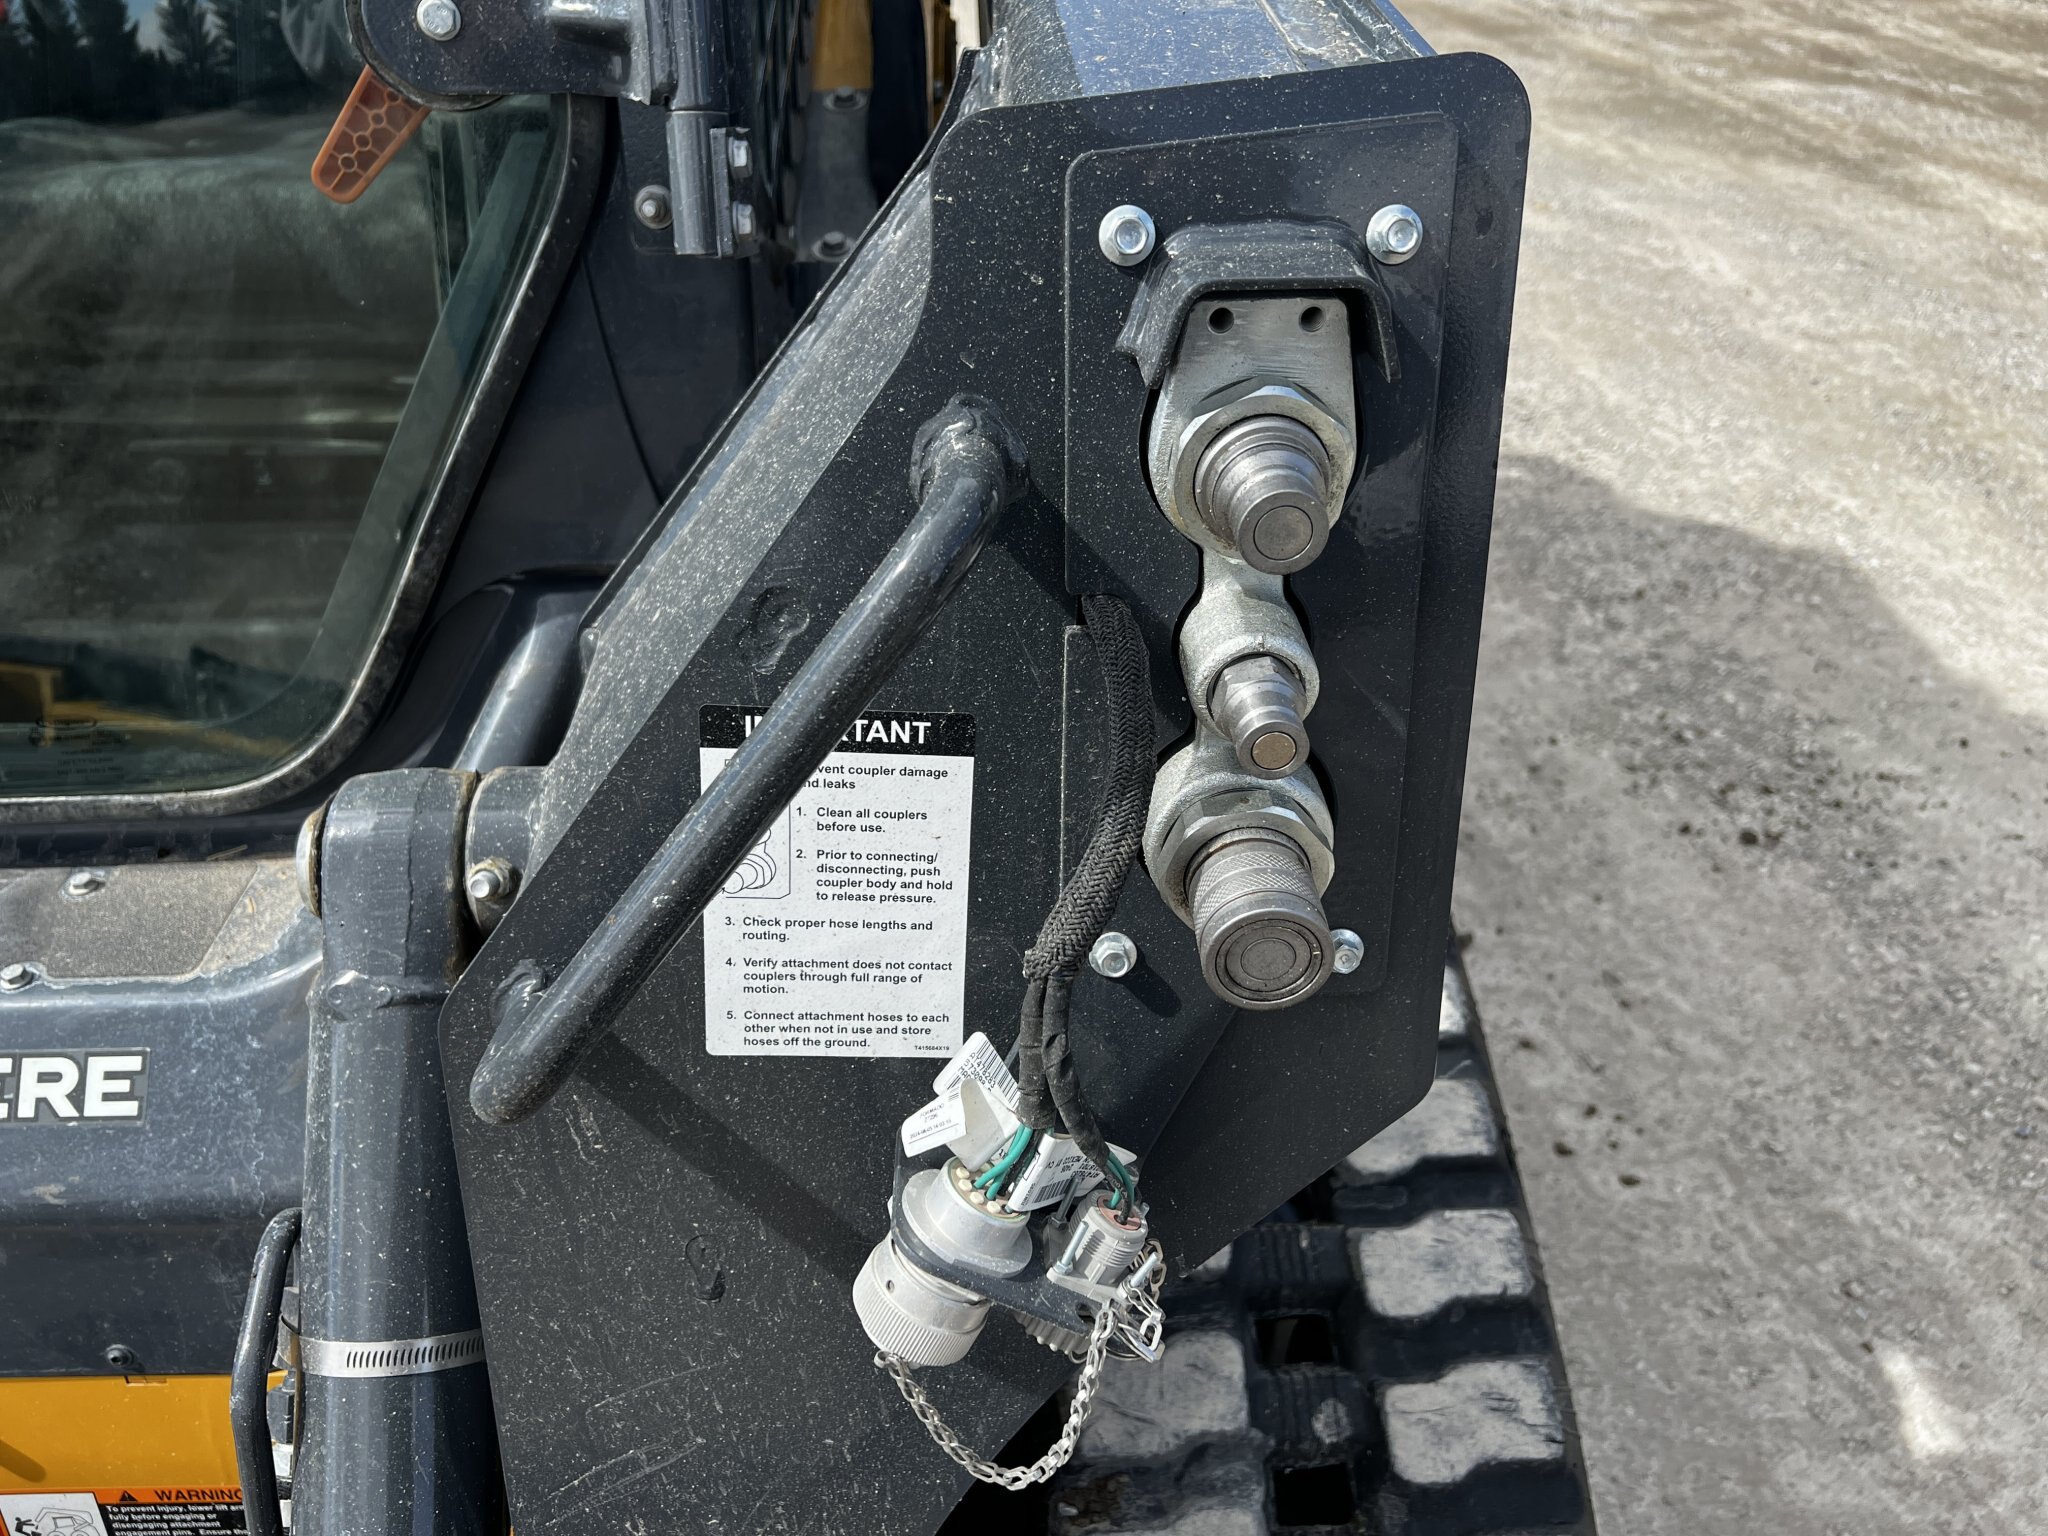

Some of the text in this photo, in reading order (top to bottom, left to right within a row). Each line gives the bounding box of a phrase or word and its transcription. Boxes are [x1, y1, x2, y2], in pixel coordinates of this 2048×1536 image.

[745, 715, 931, 744] ITANT
[816, 763, 948, 780] vent coupler damage
[803, 777, 856, 789] nd leaks
[796, 807, 927, 821] 1. Clean all couplers
[817, 821, 885, 833] before use.
[796, 849, 938, 865] 2. Prior to connecting/
[816, 863, 940, 877] disconnecting, push
[816, 878, 952, 891] coupler body and hold
[816, 892, 936, 904] to release pressure.
[725, 916, 933, 932] 3. Check proper hose lengths and
[743, 931, 789, 942] routing.
[725, 957, 952, 971] 4. Verify attachment does not contact
[744, 970, 923, 985] couplers through full range of
[743, 984, 788, 993] motion.
[727, 1010, 949, 1022] 5. Connect attachment hoses to each
[744, 1024, 775, 1033] other
[779, 1024, 810, 1033] when
[815, 1025, 833, 1033] not
[837, 1025, 847, 1033] in
[876, 1026, 898, 1034] and
[902, 1026, 931, 1035] store
[744, 1037, 870, 1048] hoses off the ground.
[105, 1505, 118, 1513] To
[121, 1505, 155, 1514] prevent
[157, 1505, 187, 1514] injury,
[215, 1504, 228, 1512] lift
[109, 1514, 129, 1523] fully
[162, 1513, 204, 1523] engaging
[112, 1521, 221, 1531] disengaging attachment
[199, 1528, 232, 1536] Ensure
